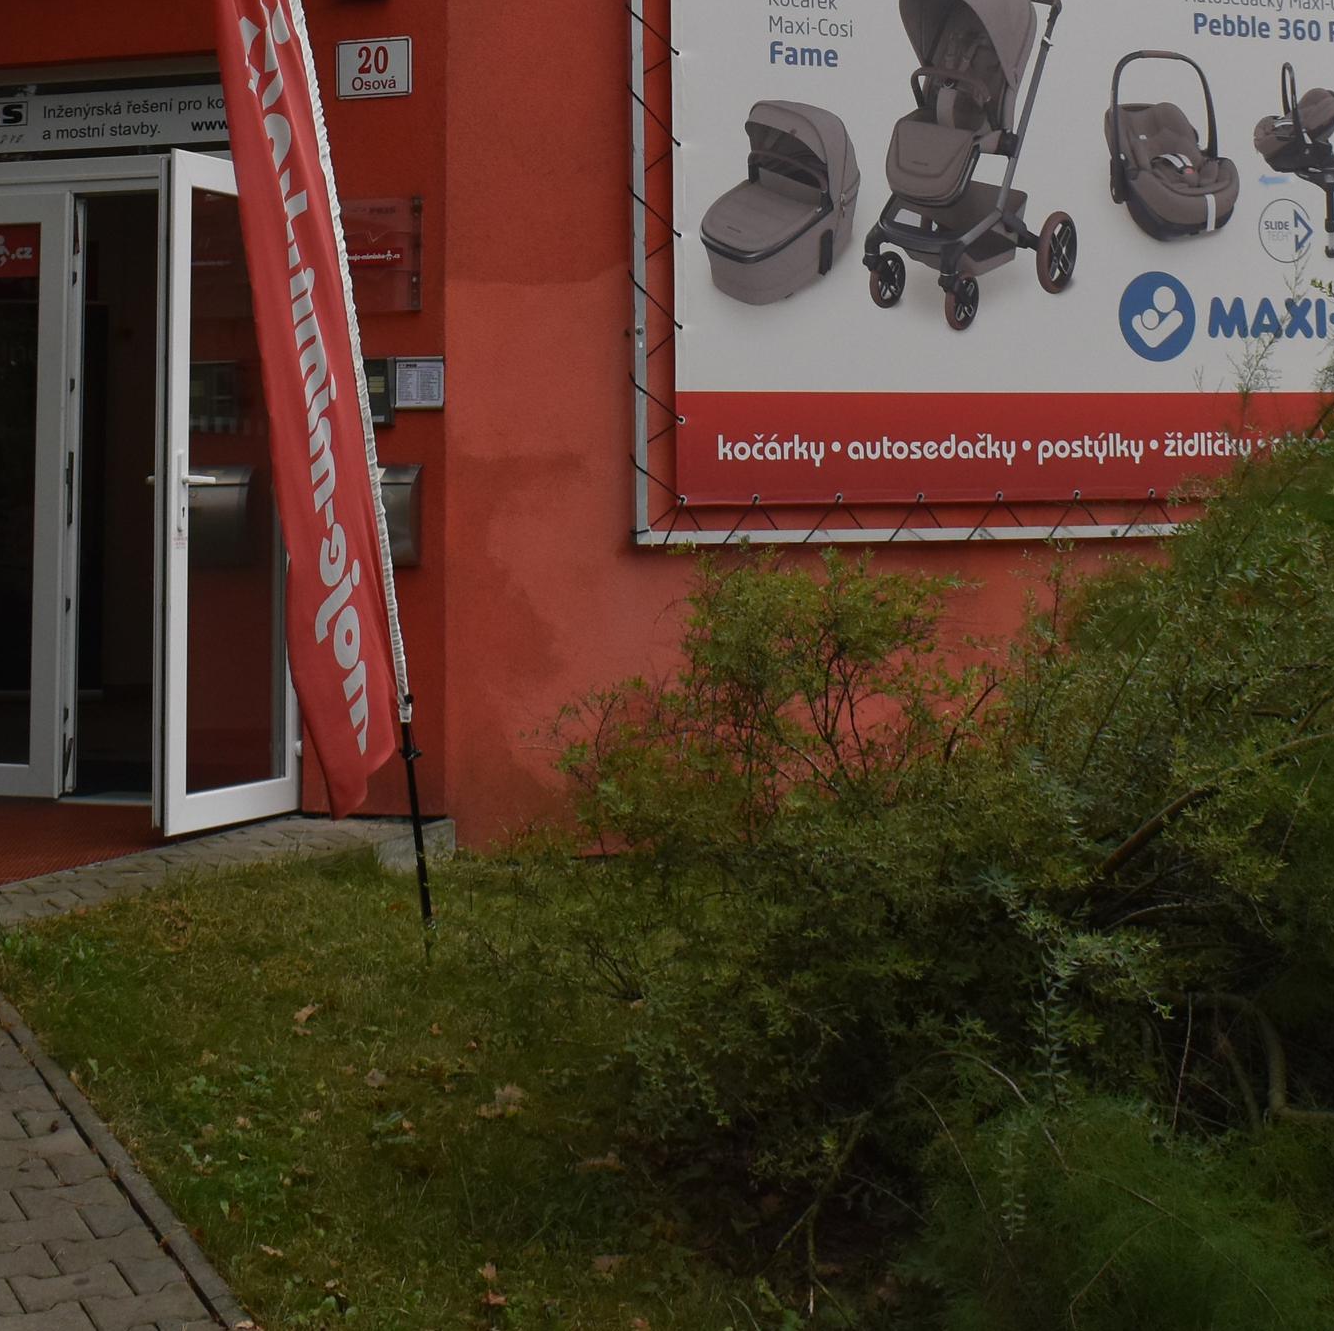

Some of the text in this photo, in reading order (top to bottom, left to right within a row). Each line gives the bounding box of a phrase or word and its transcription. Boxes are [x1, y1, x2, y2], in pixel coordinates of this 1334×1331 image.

[768, 15, 853, 38] Maxi-Cosi
[1193, 12, 1271, 39] Pebble
[1278, 17, 1321, 41] 360
[358, 45, 388, 74] 20
[769, 41, 838, 68] Fame
[352, 76, 397, 91] Osová
[43, 96, 226, 120] Inženýrská řešení pro ko
[42, 120, 228, 140] a mostní stavby. www
[1264, 220, 1290, 231] SLIDE
[718, 433, 825, 467] kočárky
[847, 433, 1016, 466] autosedačky
[1038, 432, 1144, 466] postýlky
